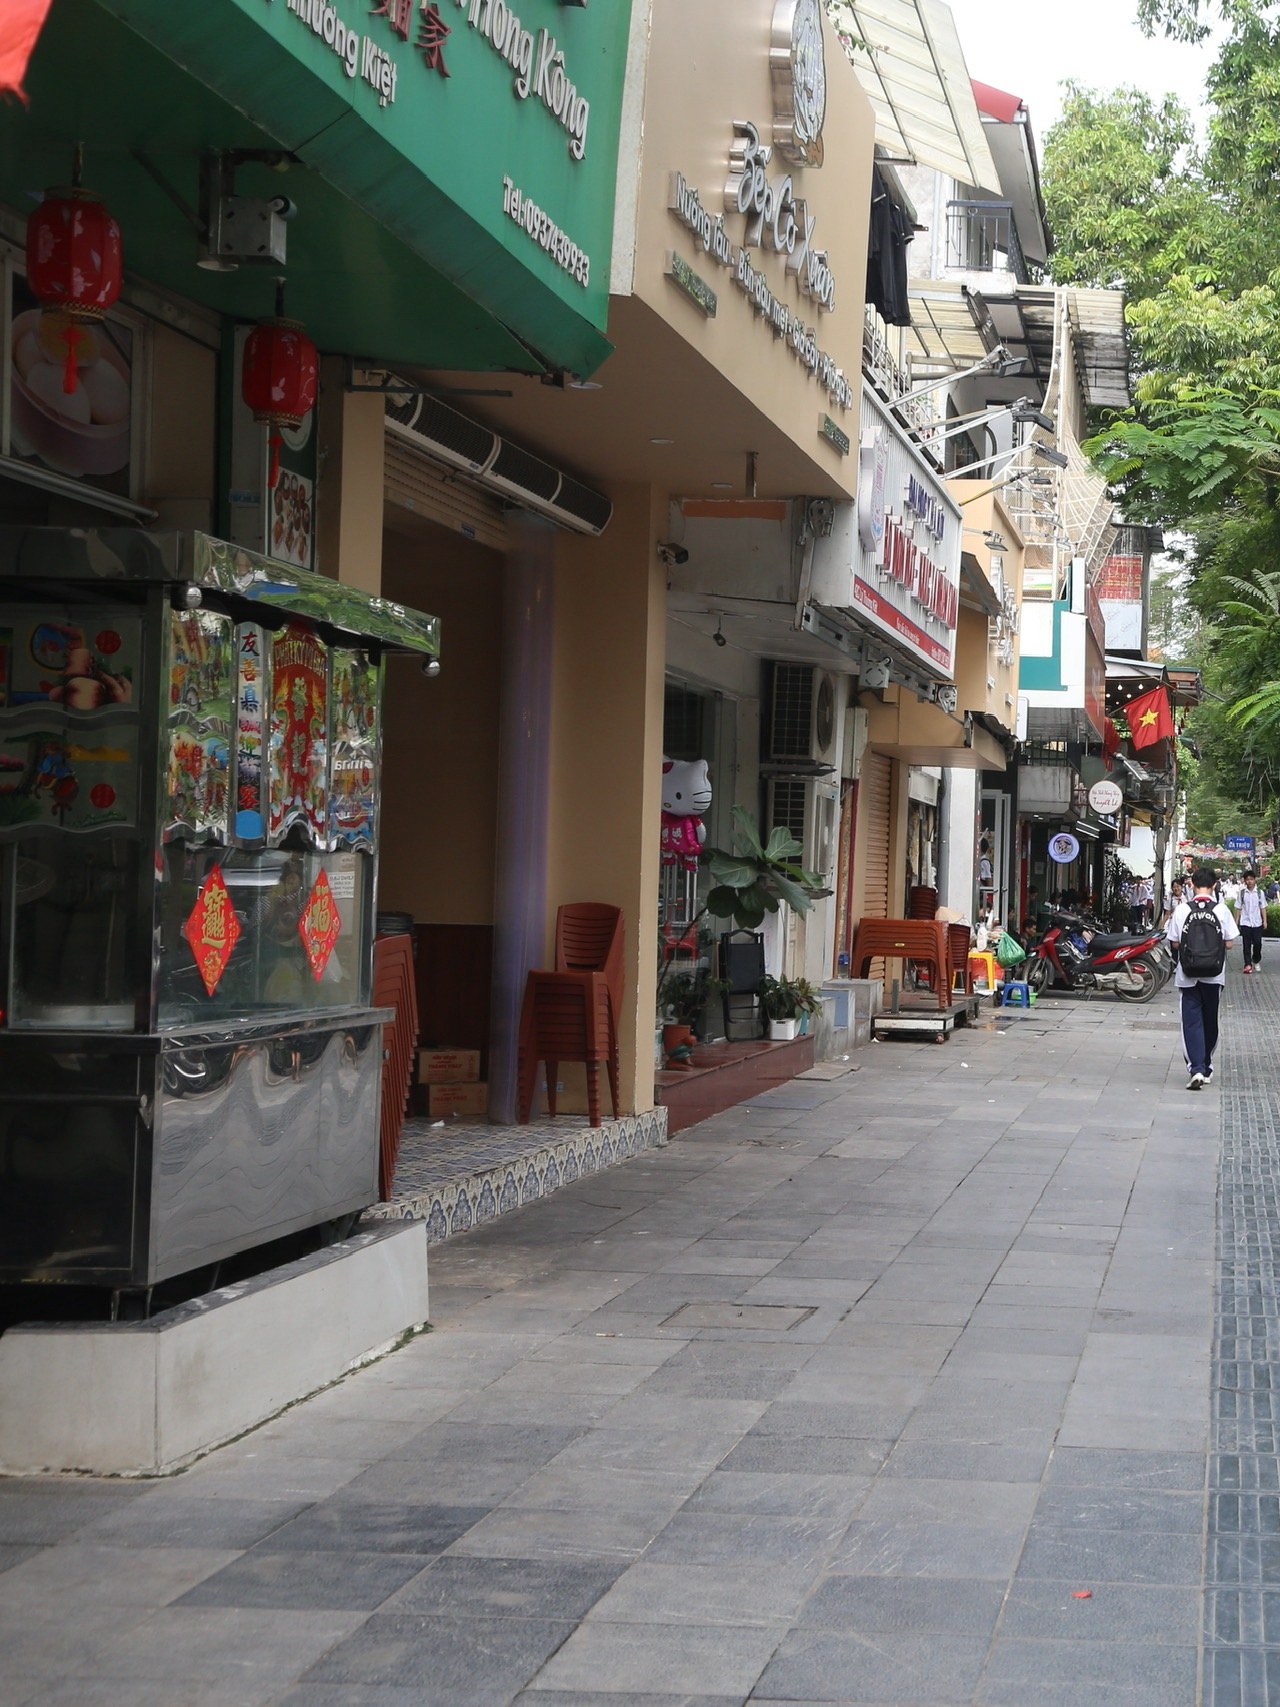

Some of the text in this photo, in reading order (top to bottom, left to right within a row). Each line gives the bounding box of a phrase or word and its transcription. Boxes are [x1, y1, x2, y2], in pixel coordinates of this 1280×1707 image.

[361, 36, 397, 107] Kiệt
[533, 28, 590, 160] Kông
[676, 171, 711, 252] Nướng
[738, 247, 754, 293] Bún
